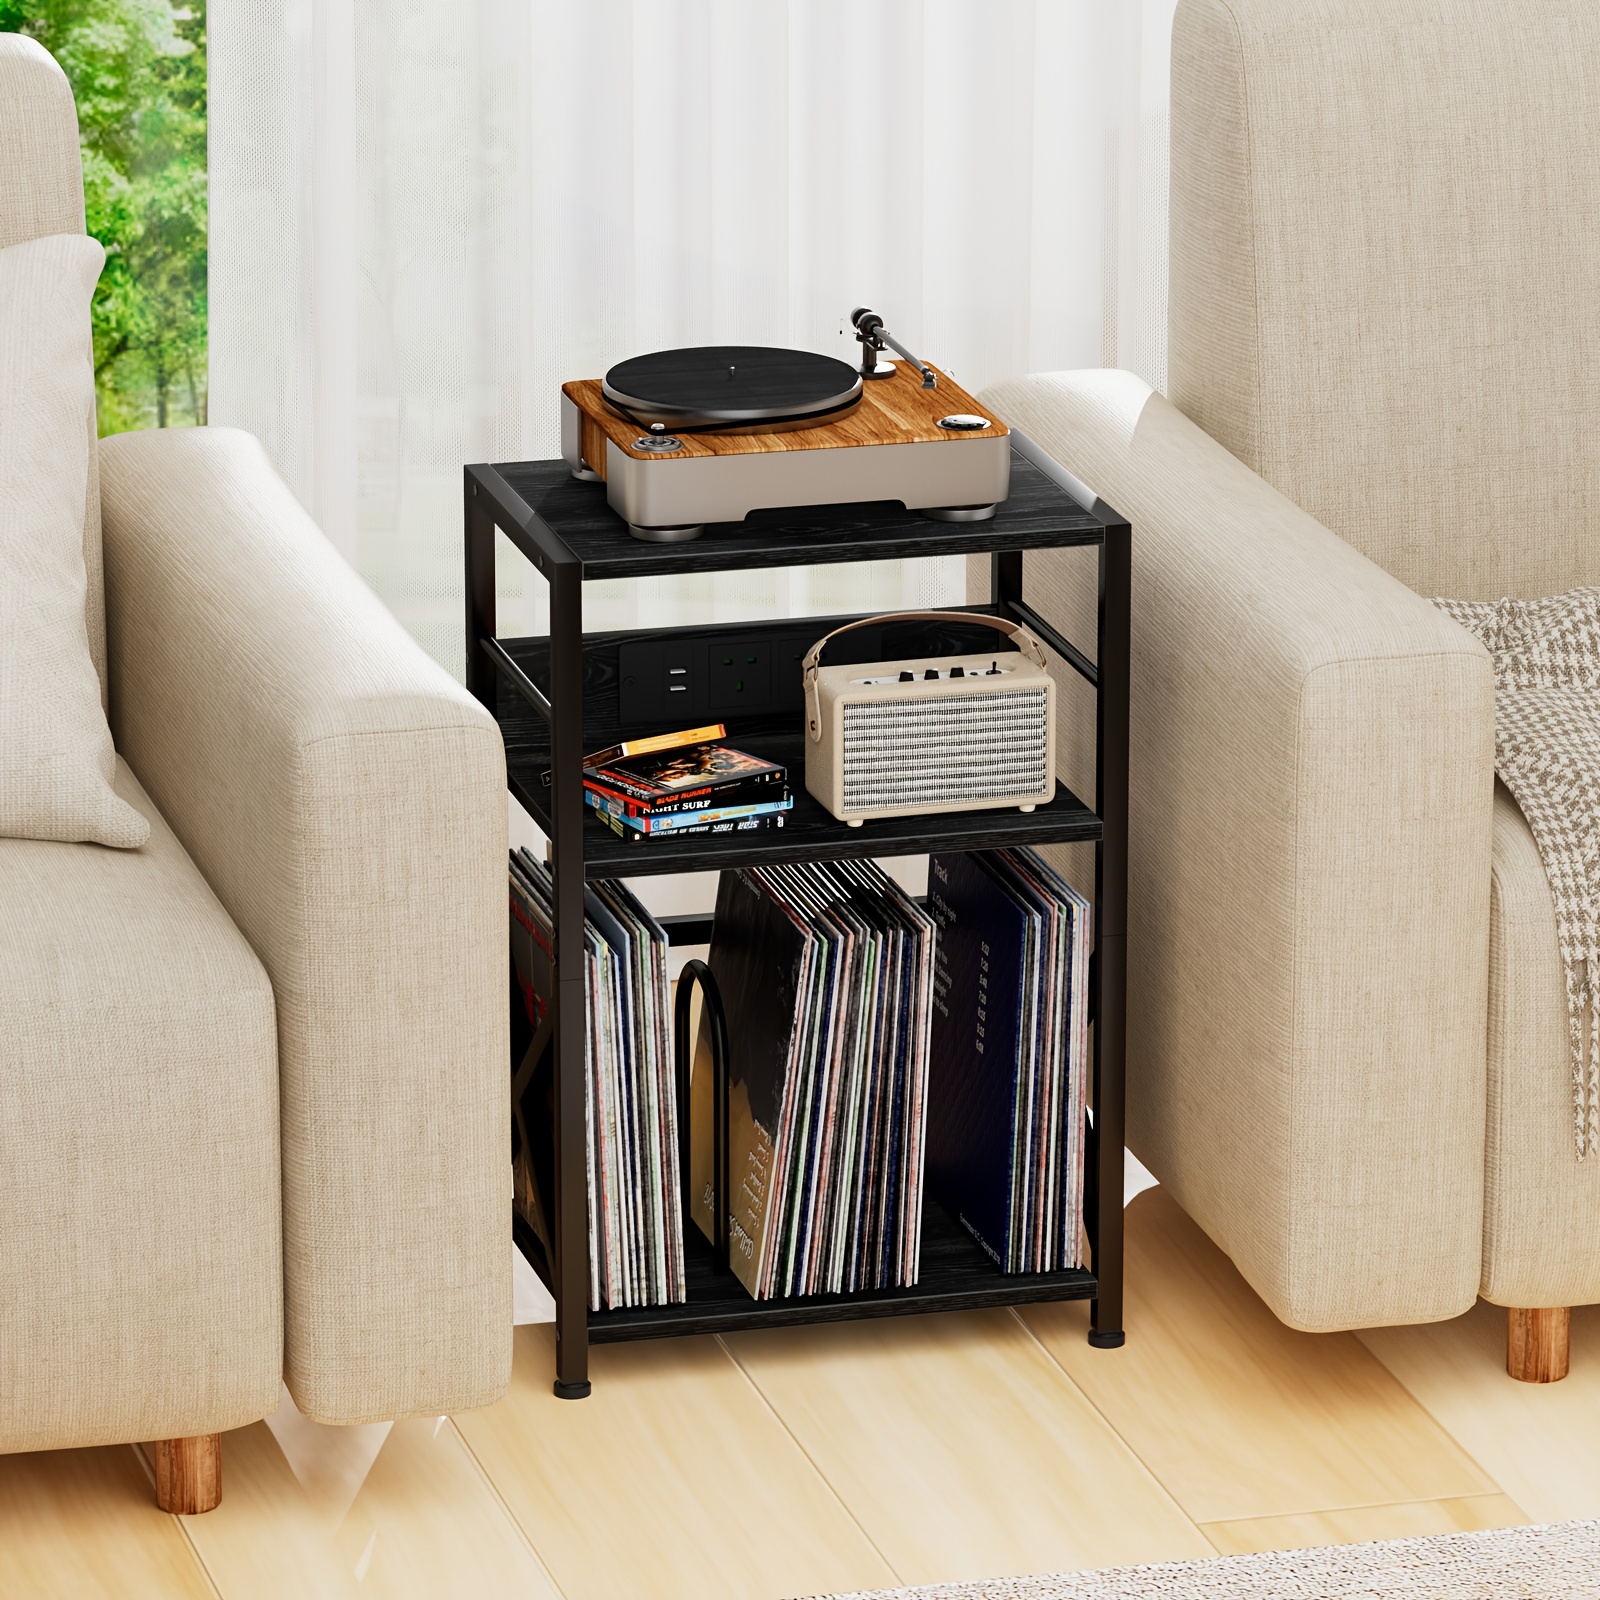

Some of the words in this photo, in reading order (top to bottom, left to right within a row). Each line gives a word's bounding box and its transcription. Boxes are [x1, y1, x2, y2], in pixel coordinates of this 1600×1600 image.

[656, 794, 679, 804] BLADE
[680, 787, 712, 799] RUNNER
[682, 800, 711, 811] SURF
